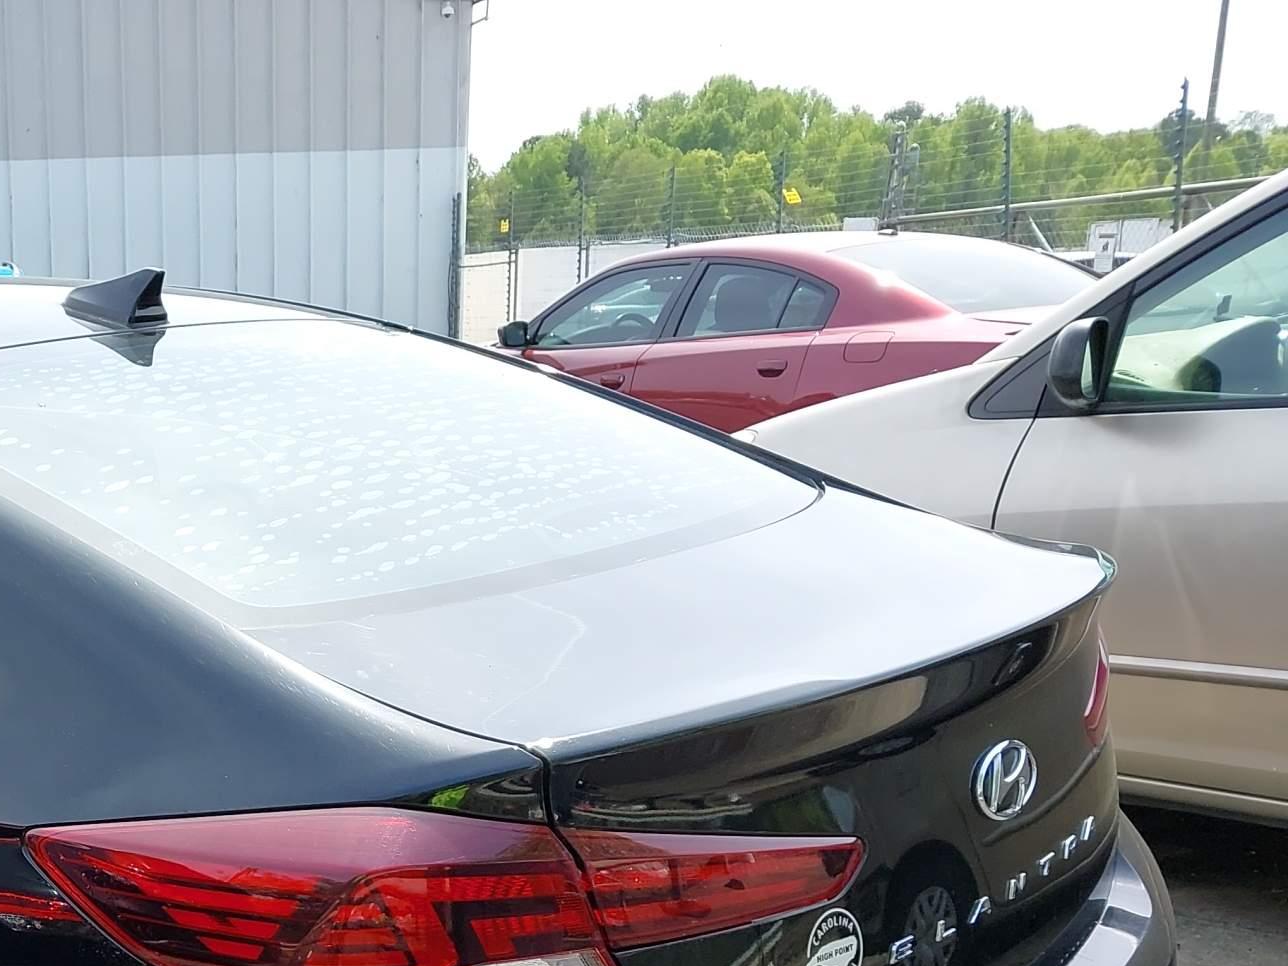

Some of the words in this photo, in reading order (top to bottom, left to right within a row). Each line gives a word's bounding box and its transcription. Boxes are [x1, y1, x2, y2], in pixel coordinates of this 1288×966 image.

[813, 915, 854, 946] CAROLINA
[816, 951, 834, 963] HIGH
[834, 943, 854, 956] POINT
